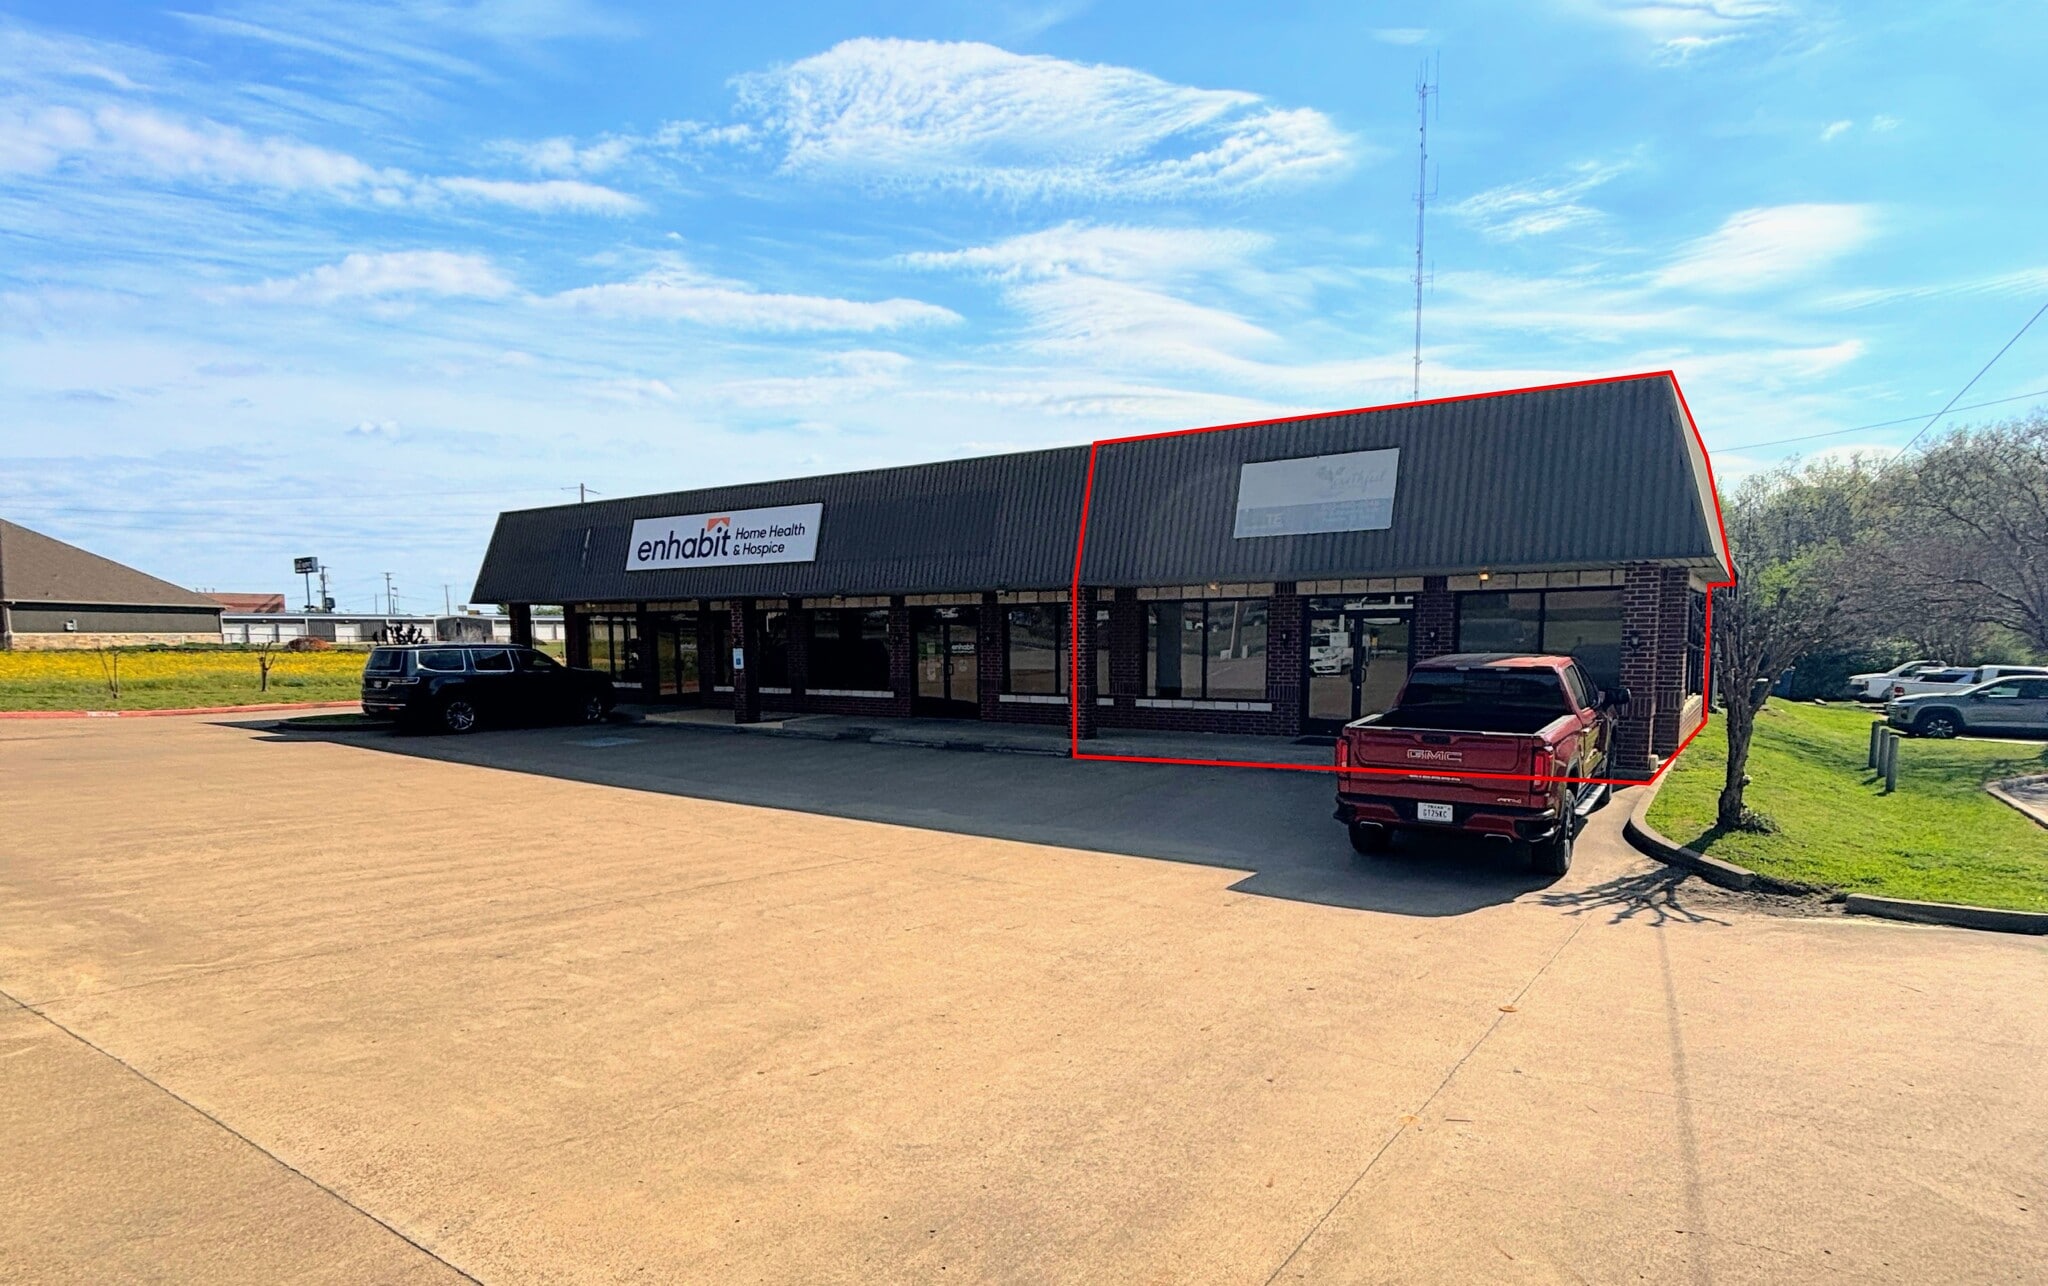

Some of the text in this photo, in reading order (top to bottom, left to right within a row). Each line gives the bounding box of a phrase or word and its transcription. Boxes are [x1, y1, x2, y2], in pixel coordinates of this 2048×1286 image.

[735, 523, 805, 540] Home Health
[637, 526, 731, 561] enhabit
[733, 541, 785, 558] & Hospice
[1407, 749, 1462, 762] GMC
